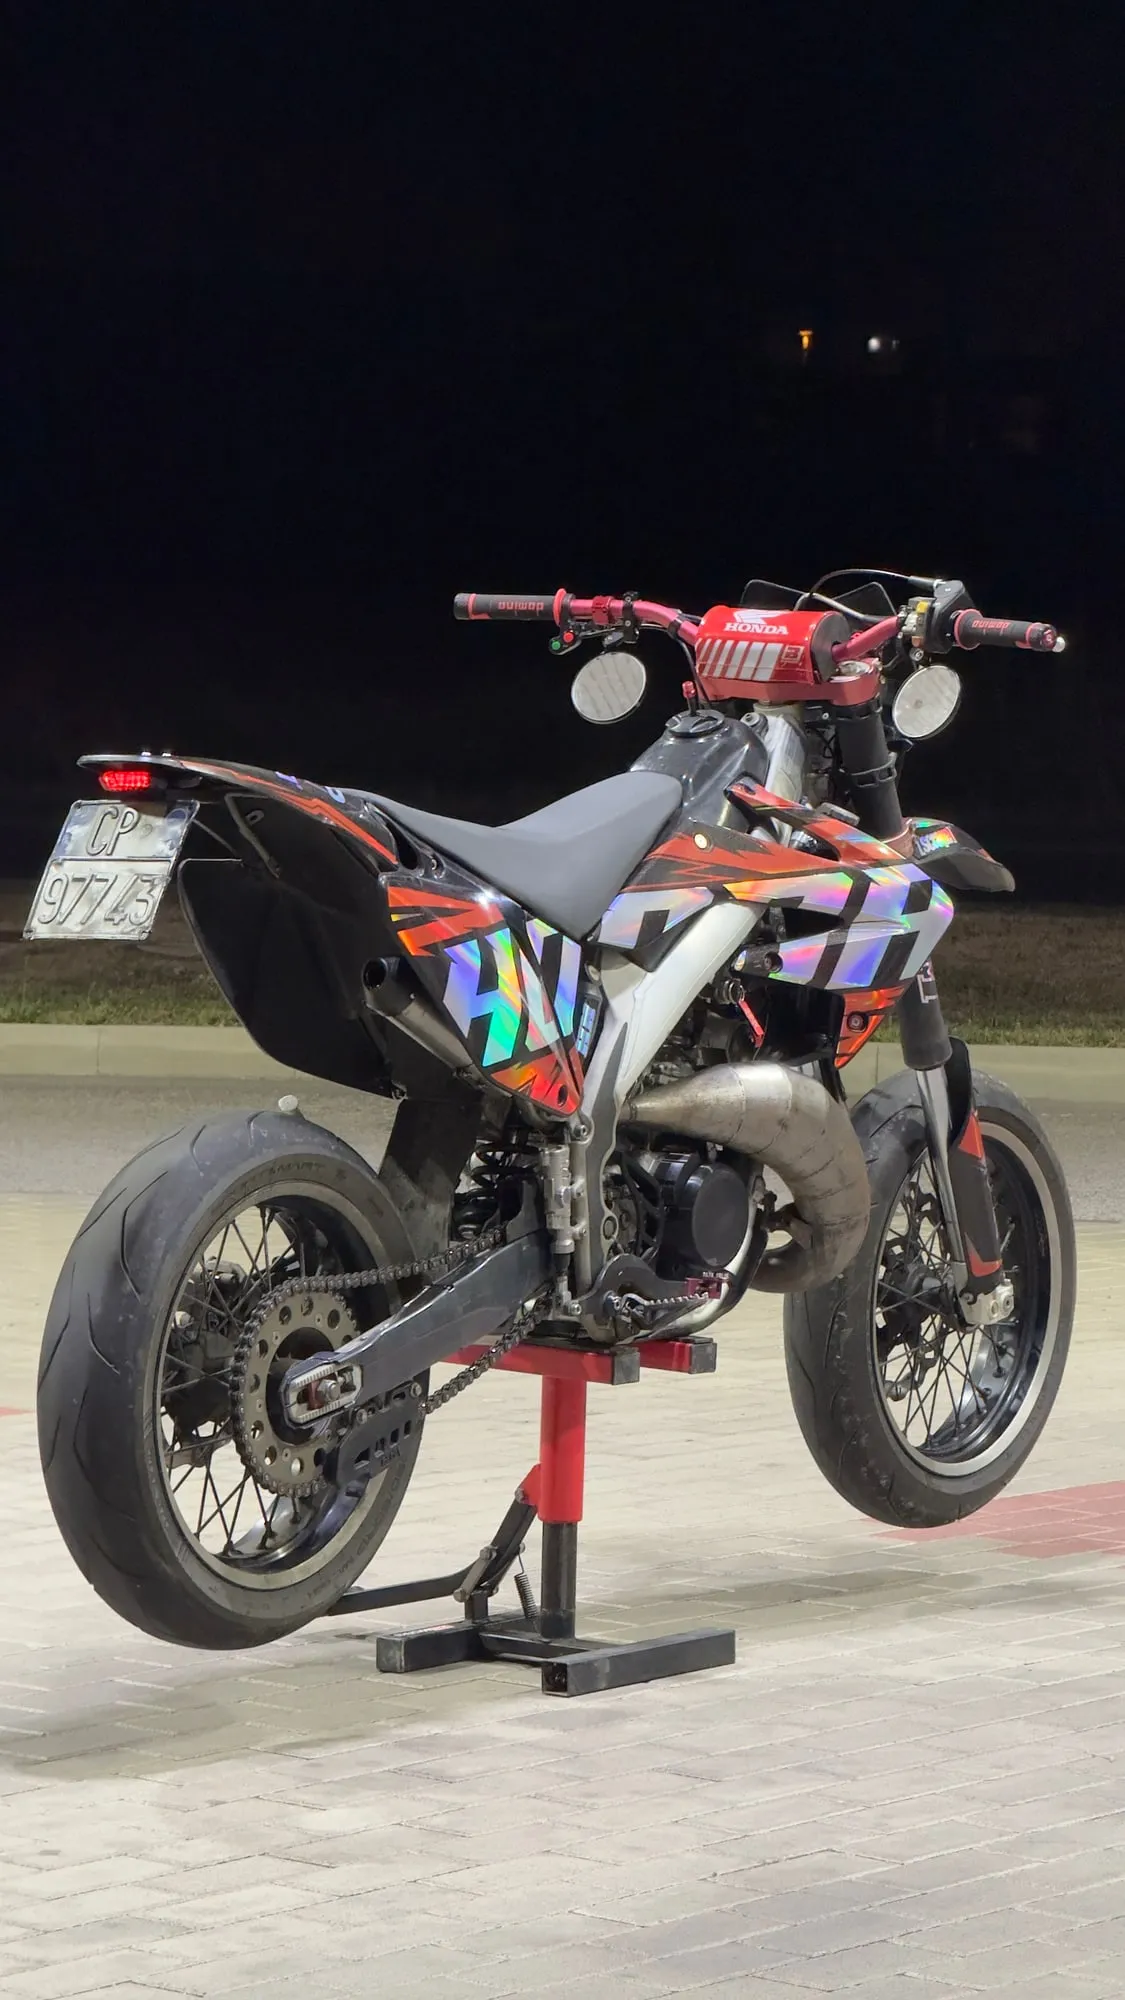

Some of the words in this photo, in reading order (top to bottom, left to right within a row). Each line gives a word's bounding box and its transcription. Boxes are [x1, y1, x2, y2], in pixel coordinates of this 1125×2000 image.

[723, 622, 789, 635] HONDA
[86, 805, 141, 857] CP
[37, 872, 160, 926] 97743
